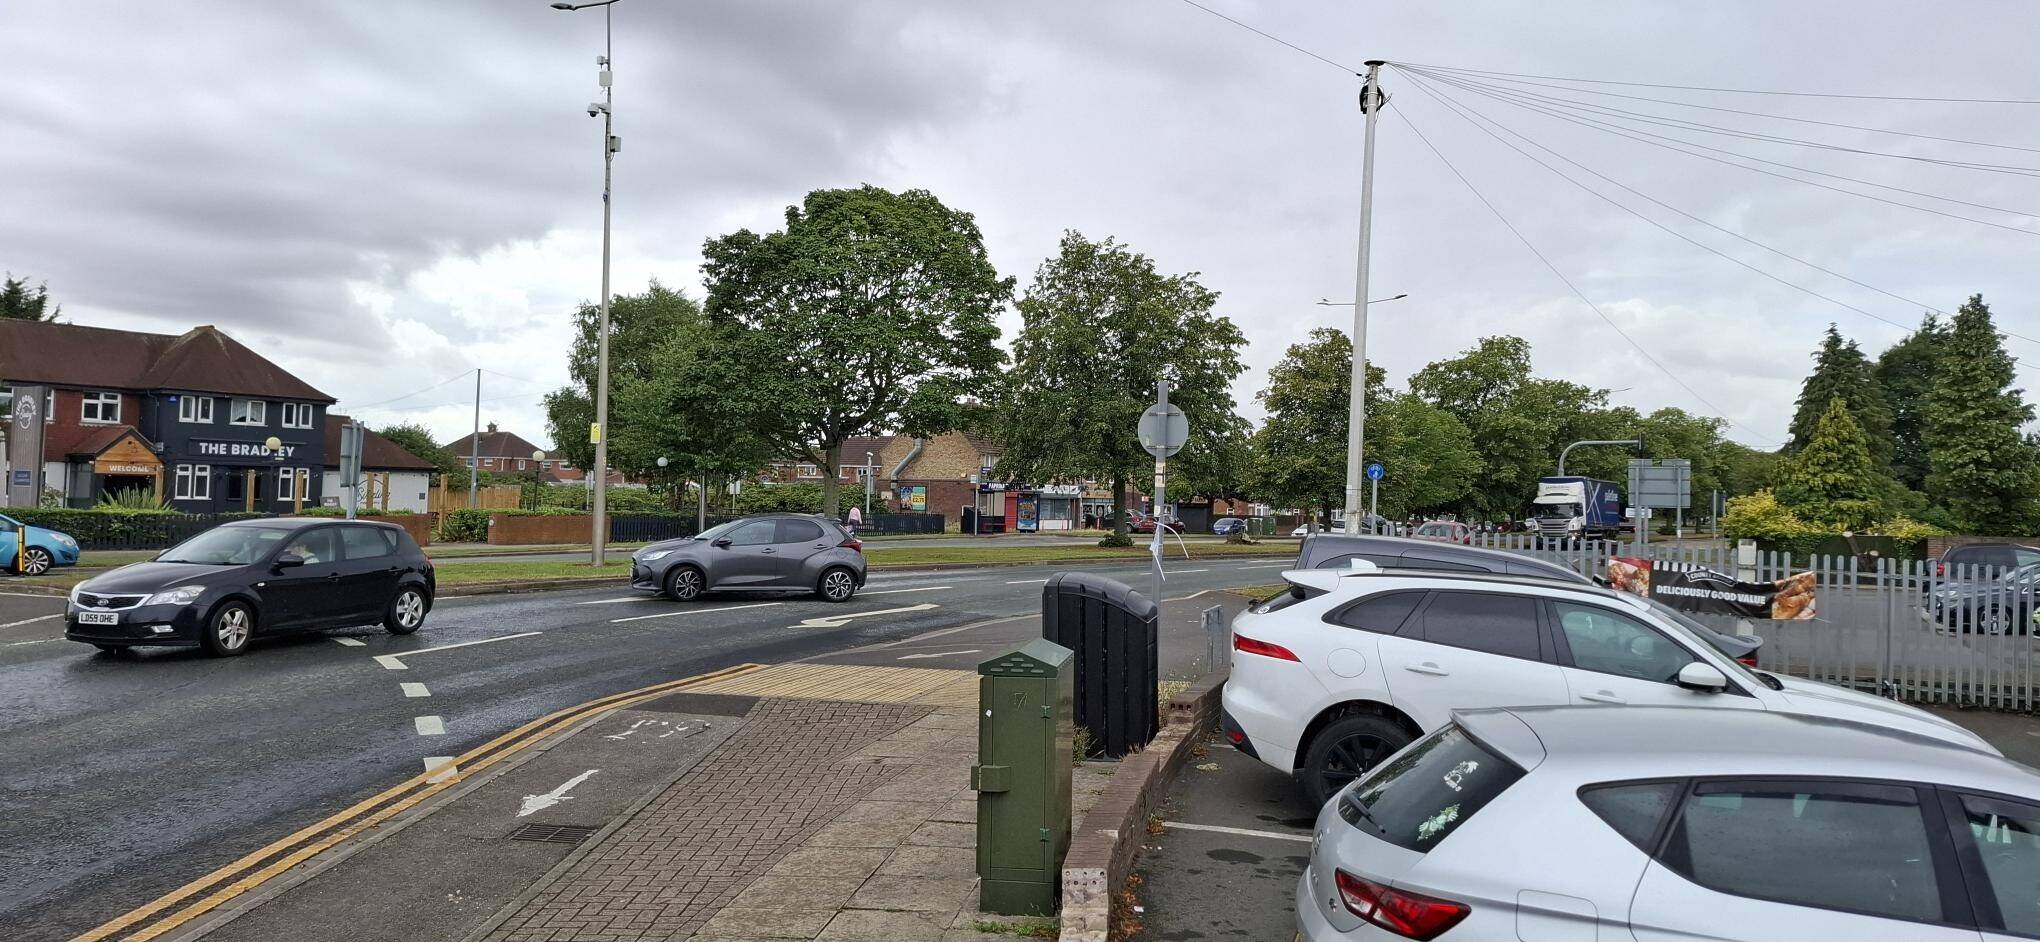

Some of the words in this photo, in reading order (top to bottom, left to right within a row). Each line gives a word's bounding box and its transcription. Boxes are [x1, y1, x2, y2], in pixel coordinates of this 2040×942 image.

[200, 442, 227, 455] THE
[231, 445, 295, 457] BRADEY
[1656, 585, 1710, 598] DELICIOUSLY
[1711, 590, 1736, 601] GOOD
[1737, 594, 1766, 605] VALUE
